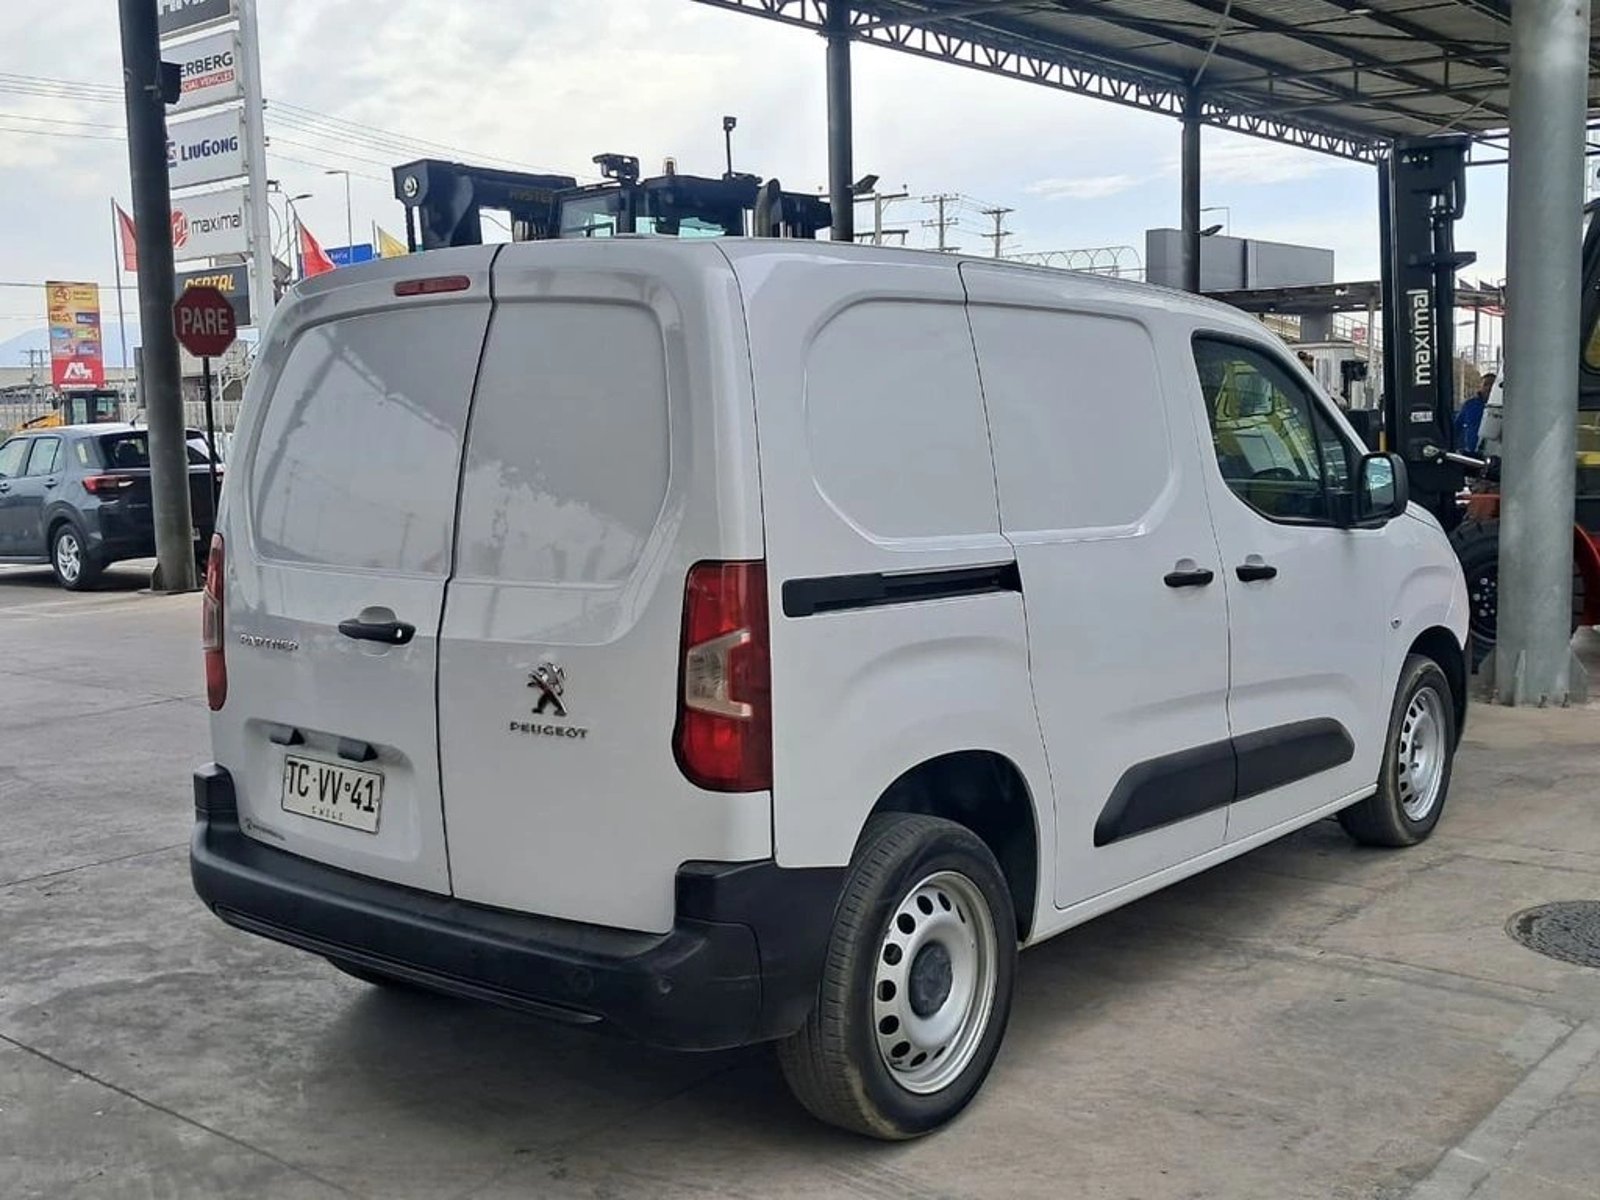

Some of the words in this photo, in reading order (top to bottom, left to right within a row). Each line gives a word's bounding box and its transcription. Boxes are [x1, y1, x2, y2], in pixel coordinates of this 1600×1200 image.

[180, 51, 234, 77] ERBERG
[191, 206, 242, 234] maximal
[180, 307, 229, 335] PARE
[1406, 289, 1431, 385] maximal
[240, 633, 299, 651] PARTNER
[510, 722, 588, 738] PEUGEOT
